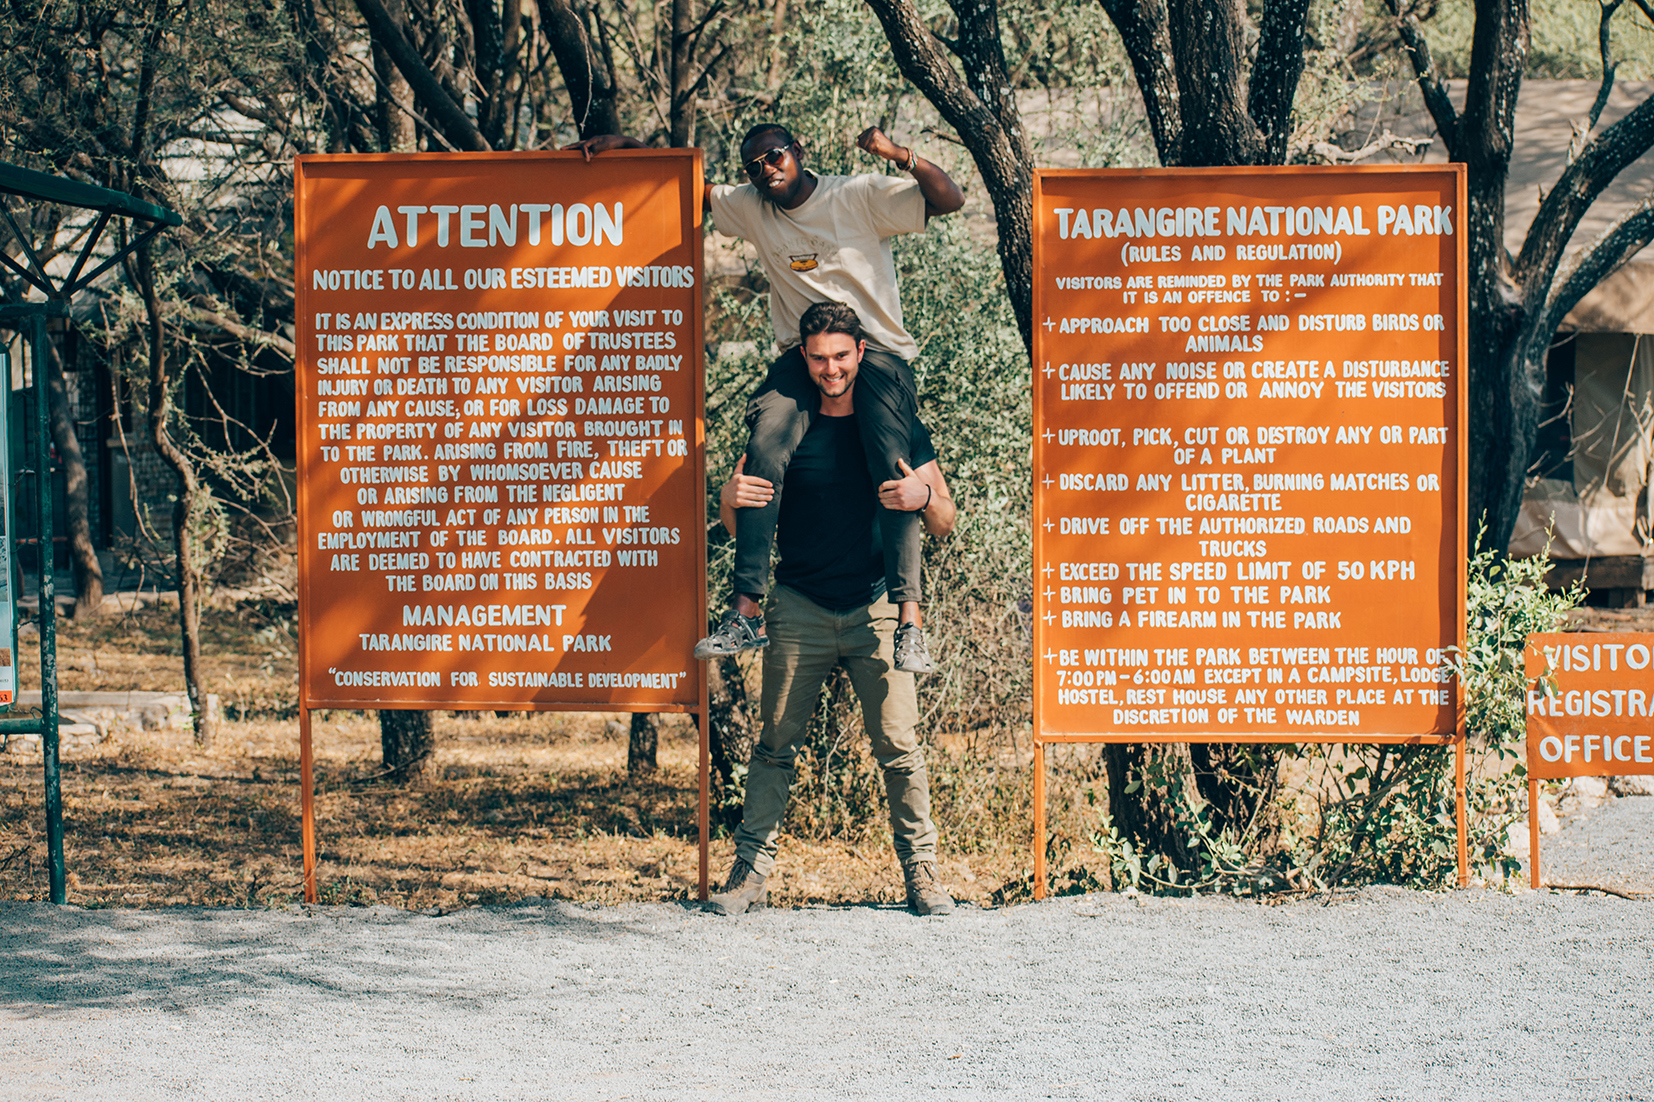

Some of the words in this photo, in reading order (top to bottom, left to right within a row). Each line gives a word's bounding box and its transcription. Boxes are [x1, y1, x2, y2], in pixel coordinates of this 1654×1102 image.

[367, 201, 624, 250] ATTENTION
[1053, 206, 1222, 240] TARANGIRE
[1226, 205, 1371, 237] NATIONAL
[1377, 204, 1454, 236] PARK
[1120, 241, 1182, 268] (RULES
[1190, 244, 1226, 262] AND
[1236, 240, 1342, 266] REGULATION)
[313, 269, 385, 291] NOTICE
[387, 268, 416, 290] TO
[418, 268, 459, 291] ALL
[463, 267, 507, 290] OUR
[510, 266, 613, 289] ESTEEMED
[614, 265, 695, 289] VISITORS
[1055, 276, 1123, 290] VISITORS
[1126, 275, 1154, 289] ARE
[1157, 274, 1227, 289] REMINDED
[1231, 274, 1252, 288] BY
[1255, 273, 1283, 288] THE
[1289, 273, 1325, 288] PARK
[1329, 273, 1406, 287] AUTHORITY
[1408, 272, 1444, 287] THAT
[1059, 316, 1150, 334] APPROACH
[1158, 315, 1192, 333] TOO
[1197, 314, 1251, 333] CLOSE
[1256, 314, 1290, 332] AND
[1298, 313, 1367, 332] DISTURB
[1372, 313, 1420, 332] BIRDS
[1422, 313, 1445, 332] OR
[315, 333, 354, 352] THIS
[356, 333, 400, 353] PARK
[403, 333, 449, 352] THAT
[454, 333, 491, 353] THE
[494, 332, 554, 352] BOARD
[562, 331, 586, 351] OF
[587, 331, 677, 351] TRUSTEES
[1184, 334, 1264, 353] ANIMALS
[317, 356, 372, 375] SHALL
[377, 356, 412, 375] NOT
[418, 355, 441, 374] BE
[444, 354, 557, 374] RESPONSIBLE
[564, 354, 598, 373] FOR
[600, 354, 632, 372] ANY
[635, 354, 683, 372] BADLY
[1058, 362, 1112, 381] CAUSE
[1119, 362, 1157, 381] ANY
[1165, 361, 1217, 380] NOISE
[1222, 361, 1246, 380] OR
[1251, 360, 1320, 380] CREATE
[1323, 360, 1336, 379] A
[1342, 359, 1450, 379] DISTURBANCE
[1061, 383, 1116, 401] LIKELY
[1122, 382, 1147, 400] TO
[1154, 381, 1220, 400] OFFEND
[1225, 381, 1248, 400] OR
[1258, 380, 1325, 399] ANNOY
[1334, 380, 1367, 399] THE
[1371, 380, 1447, 399] VISITORS
[317, 423, 352, 440] THE
[356, 422, 438, 441] PROPERTY
[444, 421, 465, 439] OF
[468, 421, 503, 439] ANY
[507, 420, 577, 438] VISITOR
[583, 419, 664, 438] BROUGHT
[668, 419, 683, 436] IN
[1173, 445, 1196, 465] OF
[1199, 447, 1213, 465] A
[1221, 447, 1277, 465] PLANT
[340, 465, 429, 485] OTHERWISE
[438, 464, 462, 482] BY
[469, 461, 584, 482] WHOMSOEVER
[589, 460, 643, 480] CAUSE
[1059, 473, 1129, 492] DISCARD
[1135, 473, 1173, 492] ANY
[1181, 473, 1250, 494] LITTER,
[1253, 472, 1325, 492] BURNING
[1330, 472, 1410, 492] MATCHES
[1416, 473, 1440, 492] OR
[357, 487, 379, 506] OR
[384, 485, 449, 505] ARISING
[454, 485, 499, 504] FROM
[505, 484, 538, 504] THE
[542, 483, 626, 503] NEGLIGENT
[1185, 492, 1282, 512] CIGARETTE
[1060, 516, 1110, 535] DRIVE
[1119, 517, 1150, 536] OFF
[1155, 516, 1193, 536] THE
[1198, 516, 1306, 535] AUTHORIZED
[1313, 516, 1370, 534] ROADS
[1372, 516, 1412, 534] AND
[317, 530, 422, 550] EMPLOYMENT
[429, 530, 449, 548] OF
[455, 529, 488, 547] THE
[498, 528, 561, 546] BOARD.
[565, 527, 596, 545] ALL
[602, 526, 681, 545] VISITORS
[1198, 539, 1267, 558] TRUCKS
[330, 553, 361, 572] ARE
[368, 552, 430, 571] DEEMED
[435, 551, 457, 570] TO
[461, 550, 502, 569] HAVE
[509, 549, 612, 568] CONTRACTED
[616, 549, 659, 567] WITH
[1059, 562, 1120, 581] EXCEED
[1125, 562, 1163, 582] THE
[1169, 561, 1227, 581] SPEED
[1236, 560, 1292, 581] LIMIT
[1301, 560, 1327, 581] OF
[1337, 560, 1365, 581] 50
[1369, 559, 1416, 581] KPH
[385, 574, 417, 592] THE
[422, 573, 477, 592] BOARD
[479, 572, 499, 591] ON
[503, 572, 538, 591] THIS
[544, 571, 593, 590] BASIS
[1060, 586, 1112, 605] BRING
[1122, 586, 1159, 605] PET
[1167, 586, 1187, 605] IN
[1194, 585, 1221, 604] TO
[1229, 585, 1270, 605] THE
[1280, 585, 1331, 605] PARK
[402, 604, 567, 627] MANAGEMENT
[1061, 610, 1113, 629] BRING
[1118, 610, 1132, 628] A
[1137, 610, 1217, 629] FIREARM
[1222, 610, 1241, 628] IN
[1246, 610, 1287, 629] THE
[1293, 611, 1342, 630] PARK
[358, 633, 454, 652] TARANGIRE
[458, 633, 555, 653] NATIONAL
[562, 634, 612, 653] PARK
[1543, 643, 1654, 672] VISITO
[450, 671, 479, 687] FOR
[488, 671, 584, 688] SUSTAINABLE
[1057, 688, 1124, 707] HOSTEL,
[1126, 688, 1167, 705] REST
[1172, 687, 1228, 706] HOUSE
[1234, 688, 1268, 705] ANY
[1274, 688, 1328, 705] OTHER
[1335, 688, 1386, 705] PLACE
[1392, 688, 1415, 705] AT
[1417, 688, 1449, 706] THE
[1113, 707, 1209, 725] DISCRETION
[1217, 707, 1239, 725] OF
[1243, 707, 1277, 724] THE
[1285, 708, 1360, 727] WARDEN
[1539, 735, 1653, 763] OFFICE
